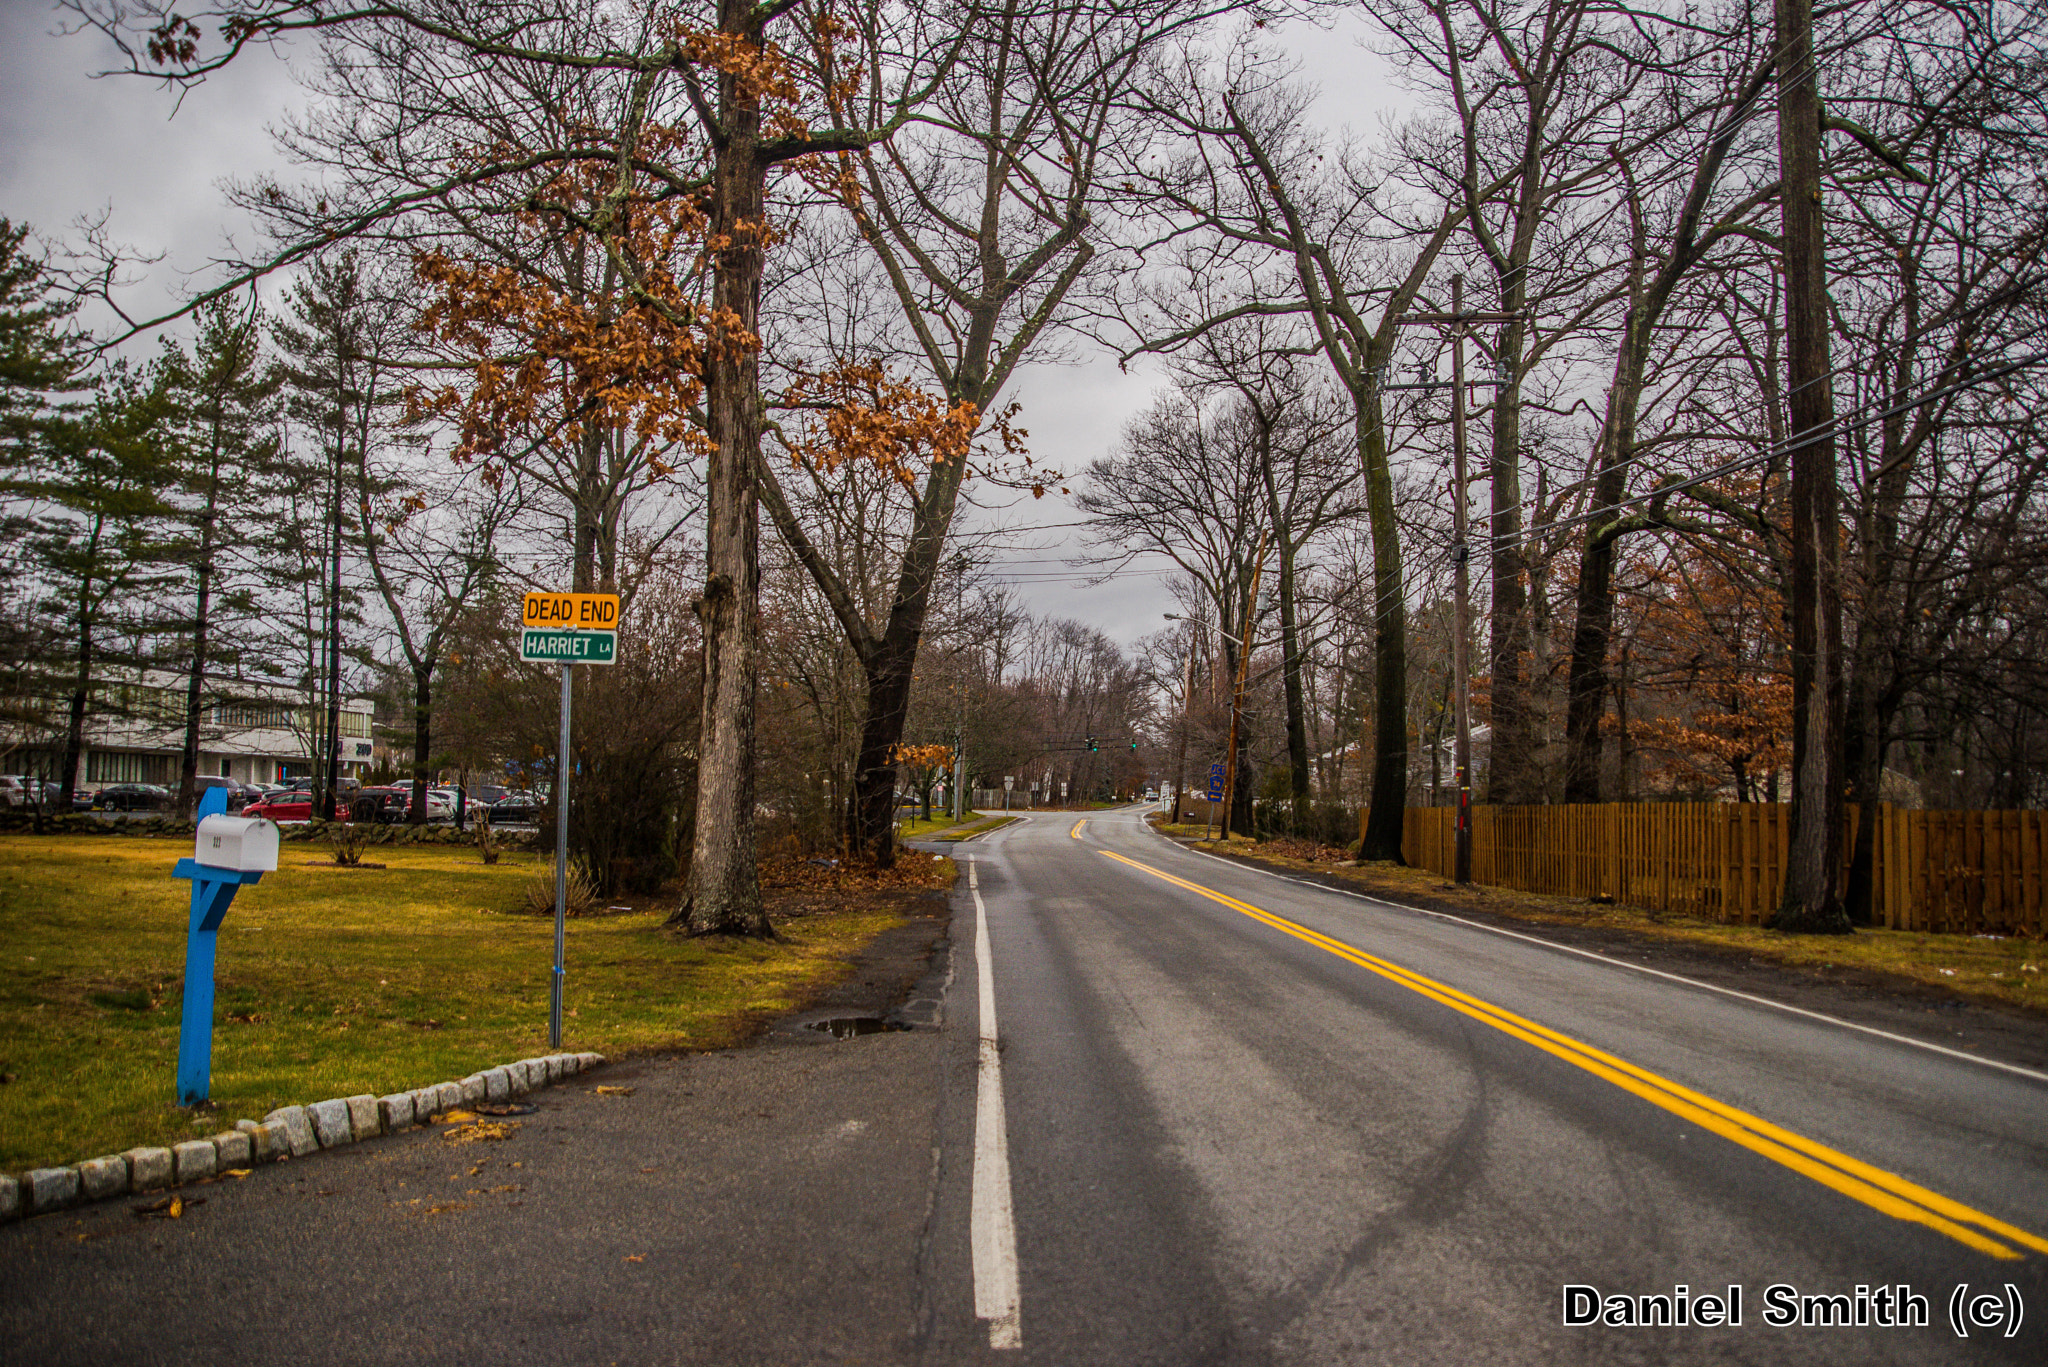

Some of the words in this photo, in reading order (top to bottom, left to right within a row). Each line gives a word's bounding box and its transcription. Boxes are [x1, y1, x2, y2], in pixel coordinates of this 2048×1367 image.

[527, 598, 573, 621] DEAD
[580, 600, 615, 622] END
[526, 636, 591, 656] HARRIET
[600, 643, 611, 653] LA
[1212, 765, 1225, 774] JCT
